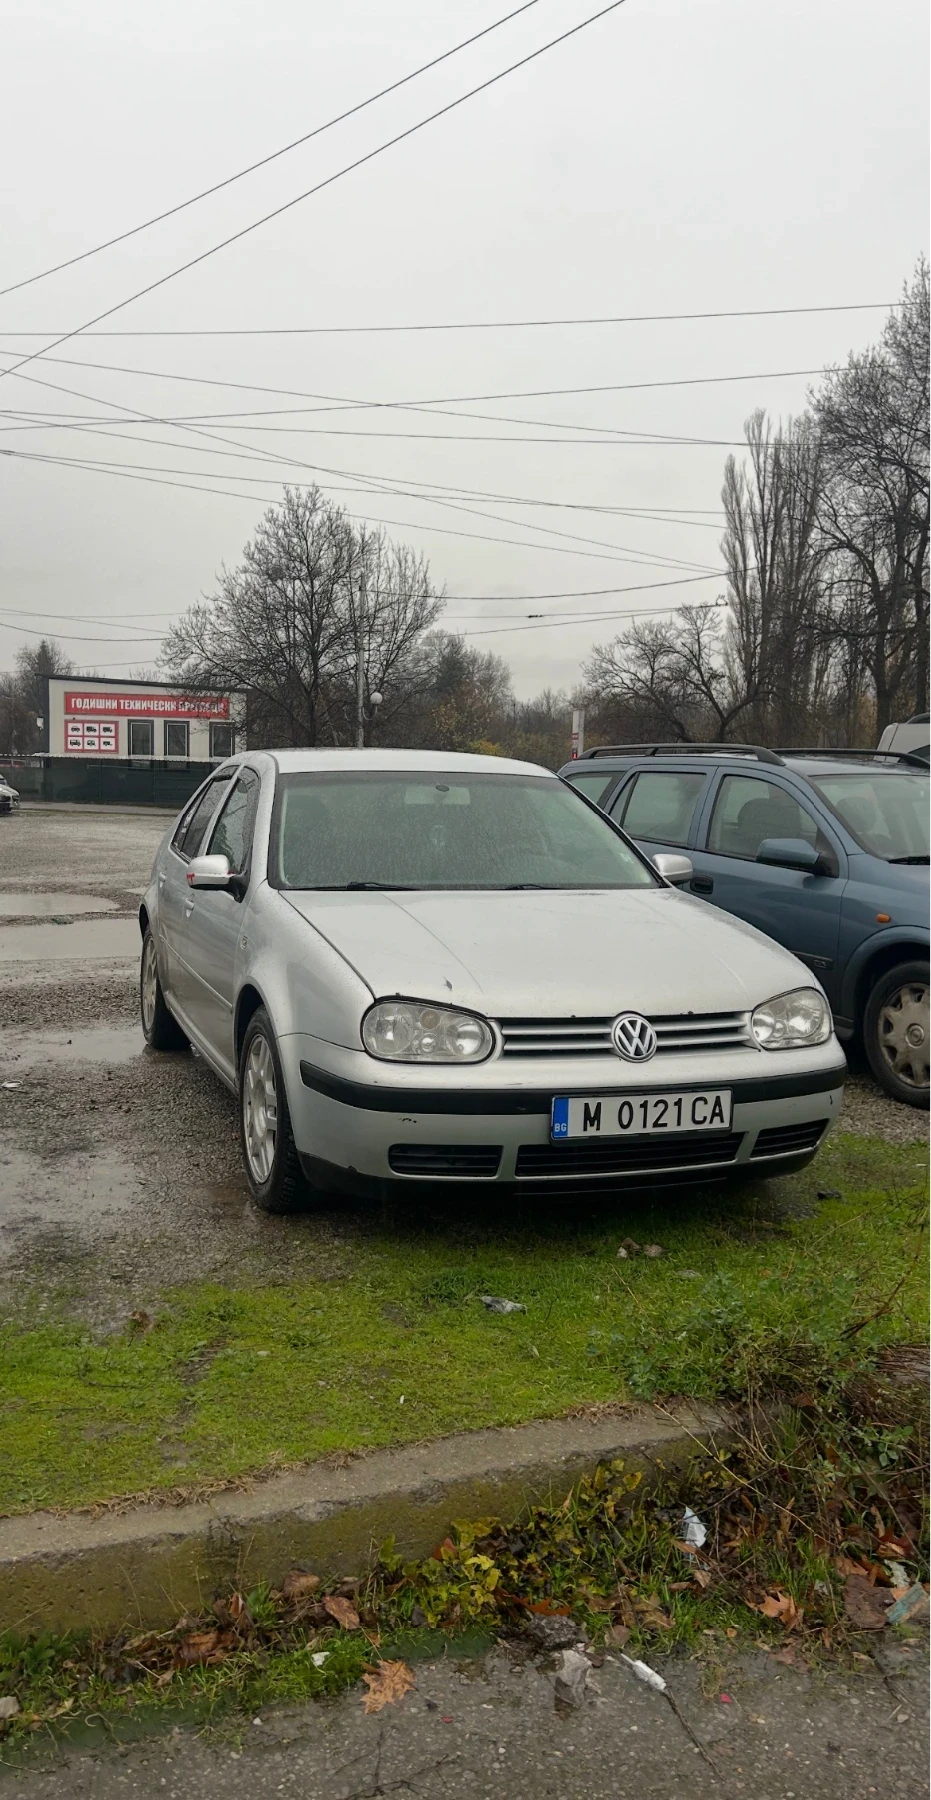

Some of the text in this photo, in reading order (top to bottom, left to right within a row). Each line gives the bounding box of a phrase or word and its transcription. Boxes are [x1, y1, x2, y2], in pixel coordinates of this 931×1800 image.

[71, 698, 118, 710] ГОДИШНИ
[119, 699, 177, 712] ТЕХНИЧЕСКИ
[583, 1102, 602, 1132] M
[554, 1123, 567, 1132] BG
